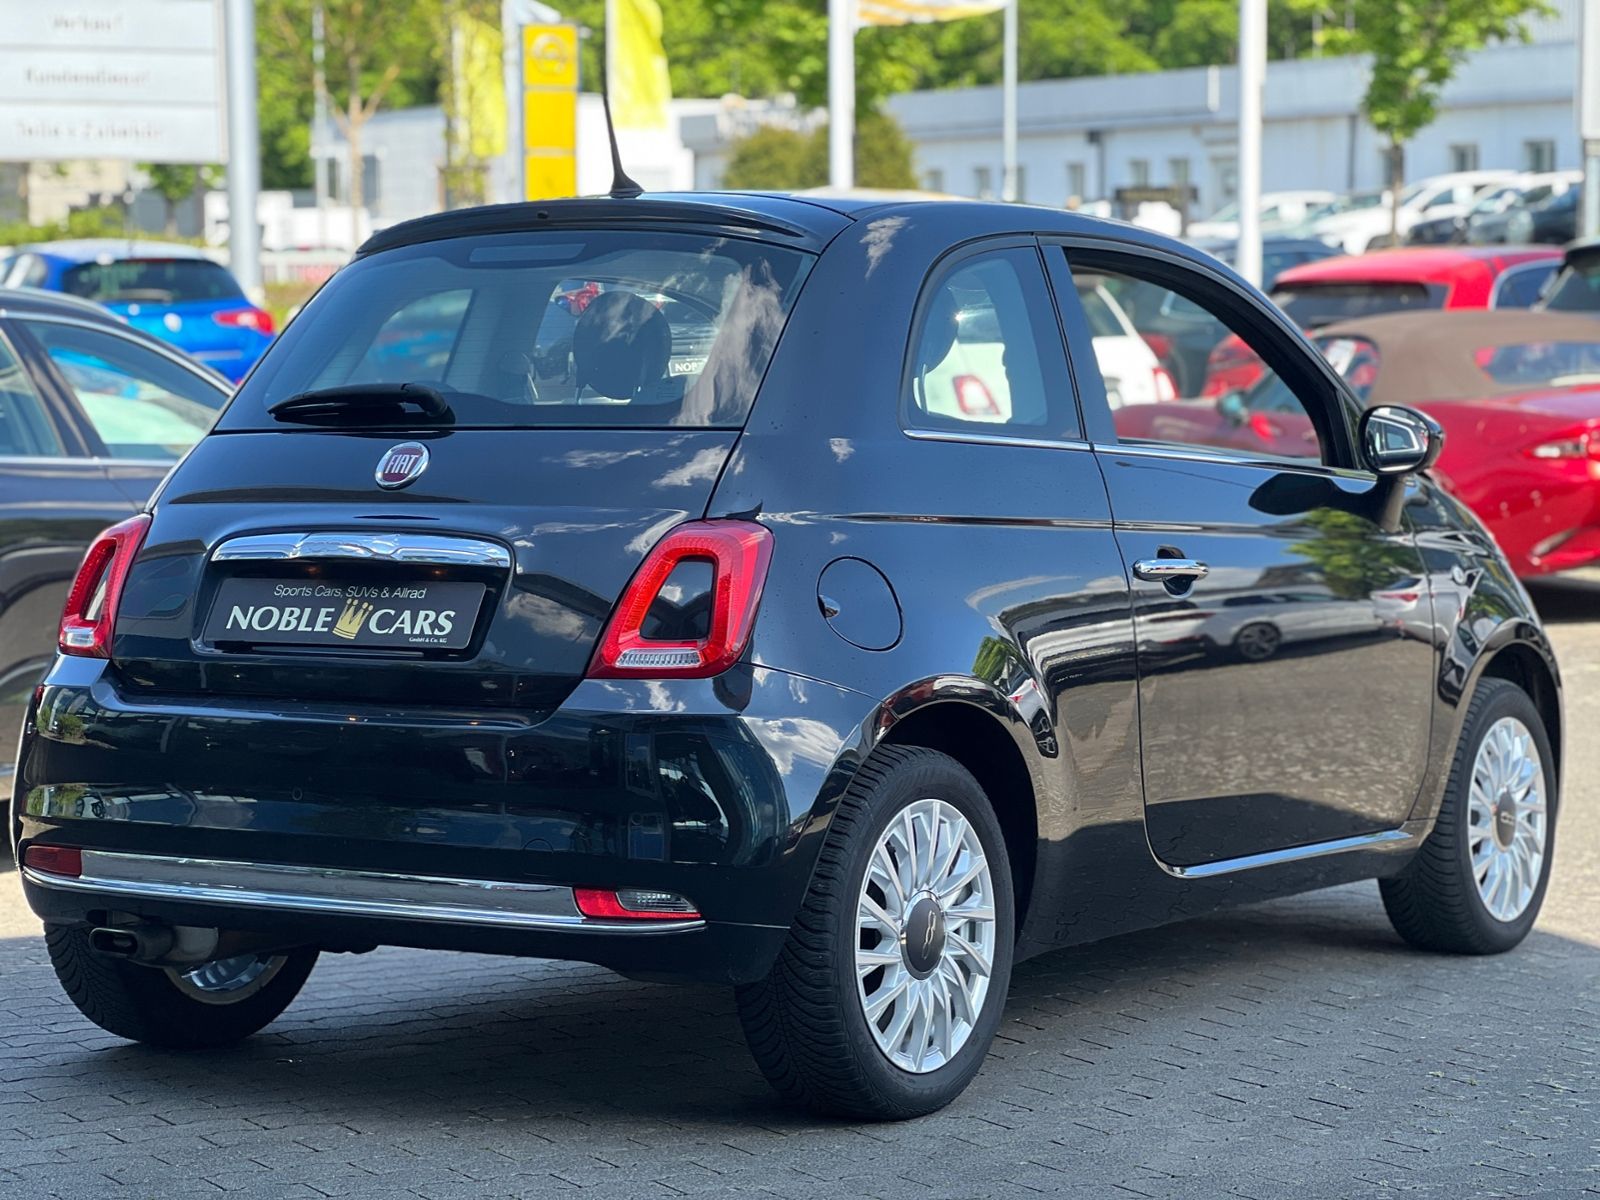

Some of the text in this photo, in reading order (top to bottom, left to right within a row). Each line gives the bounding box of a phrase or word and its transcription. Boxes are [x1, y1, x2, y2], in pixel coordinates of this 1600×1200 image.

[384, 454, 420, 474] FIAT
[273, 584, 427, 599] Sports Cars, SUVs & Allrad
[225, 605, 456, 636] NOBLE CARS
